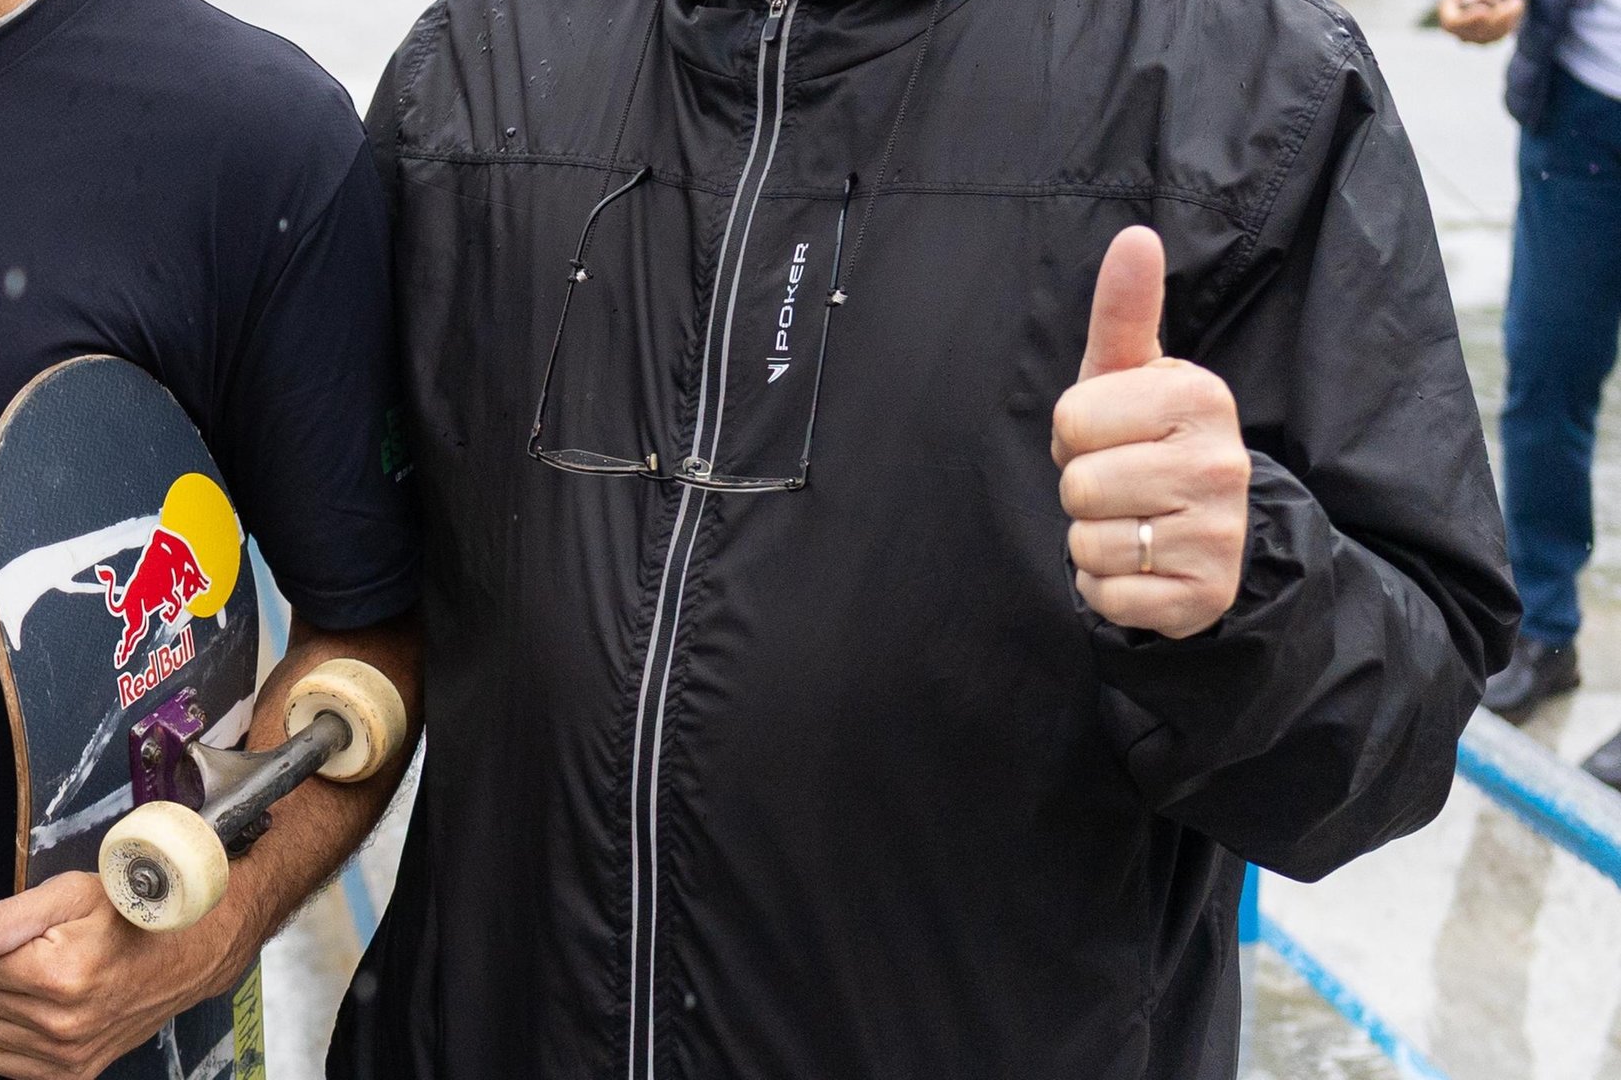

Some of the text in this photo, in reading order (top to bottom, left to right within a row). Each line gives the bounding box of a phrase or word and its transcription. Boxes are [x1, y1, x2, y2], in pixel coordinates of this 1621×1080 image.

[775, 243, 809, 351] POKER
[117, 623, 196, 710] Red Bull
